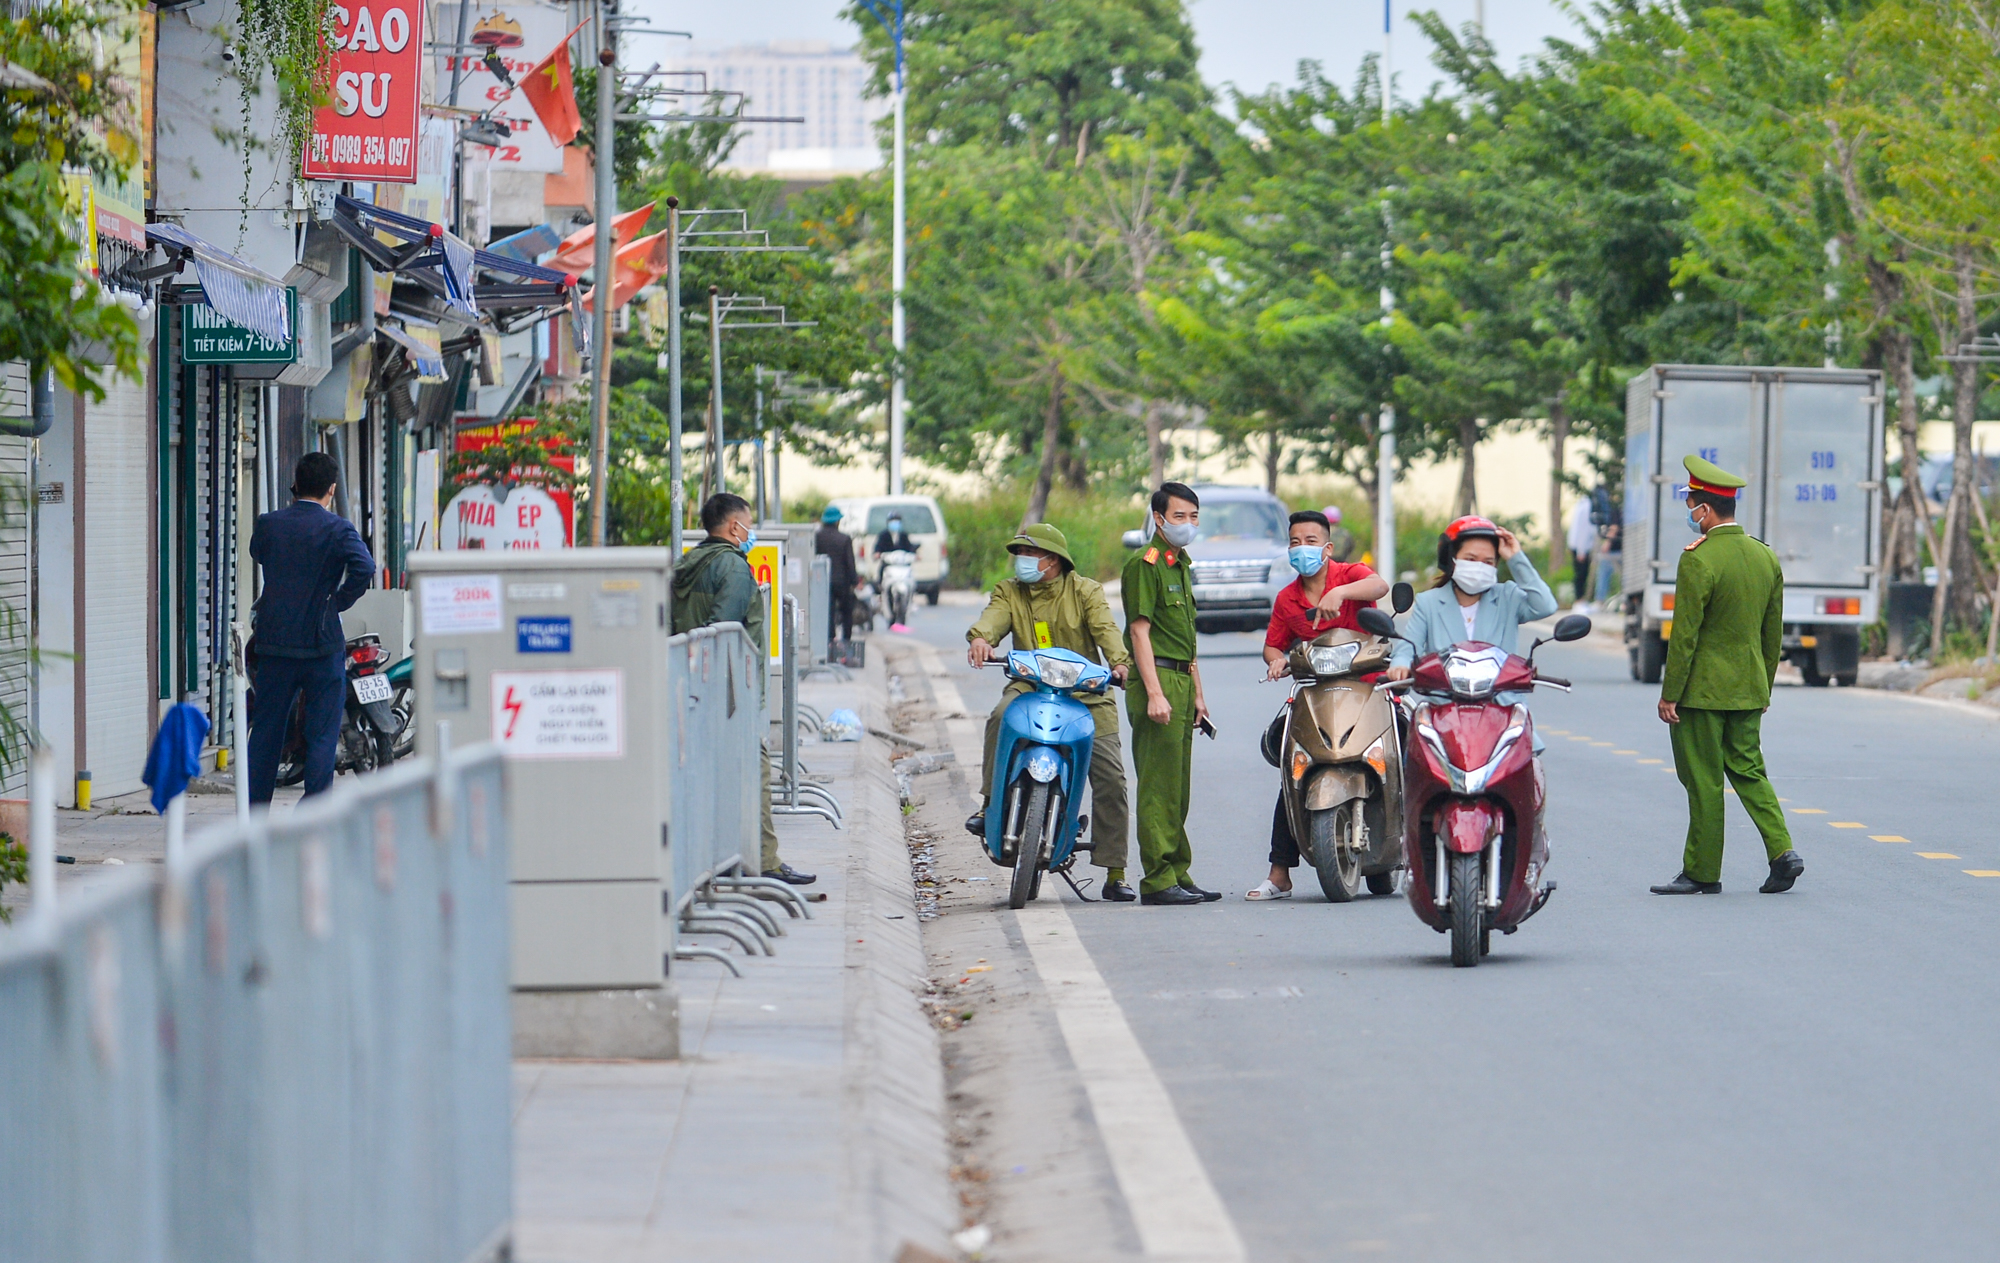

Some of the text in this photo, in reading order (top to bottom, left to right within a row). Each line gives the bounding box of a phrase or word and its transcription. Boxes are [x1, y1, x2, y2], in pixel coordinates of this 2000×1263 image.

[322, 6, 410, 53] CAO
[334, 71, 392, 118] SU
[332, 134, 362, 164] 0989
[363, 135, 385, 165] 354
[388, 136, 411, 166] 097
[193, 333, 215, 353] TIẾT
[217, 335, 244, 354] KIỆM
[459, 493, 542, 529] MÍA ÉP
[1041, 635, 1047, 644] B
[358, 676, 384, 691] 29-X5
[359, 686, 390, 702] 349.07
